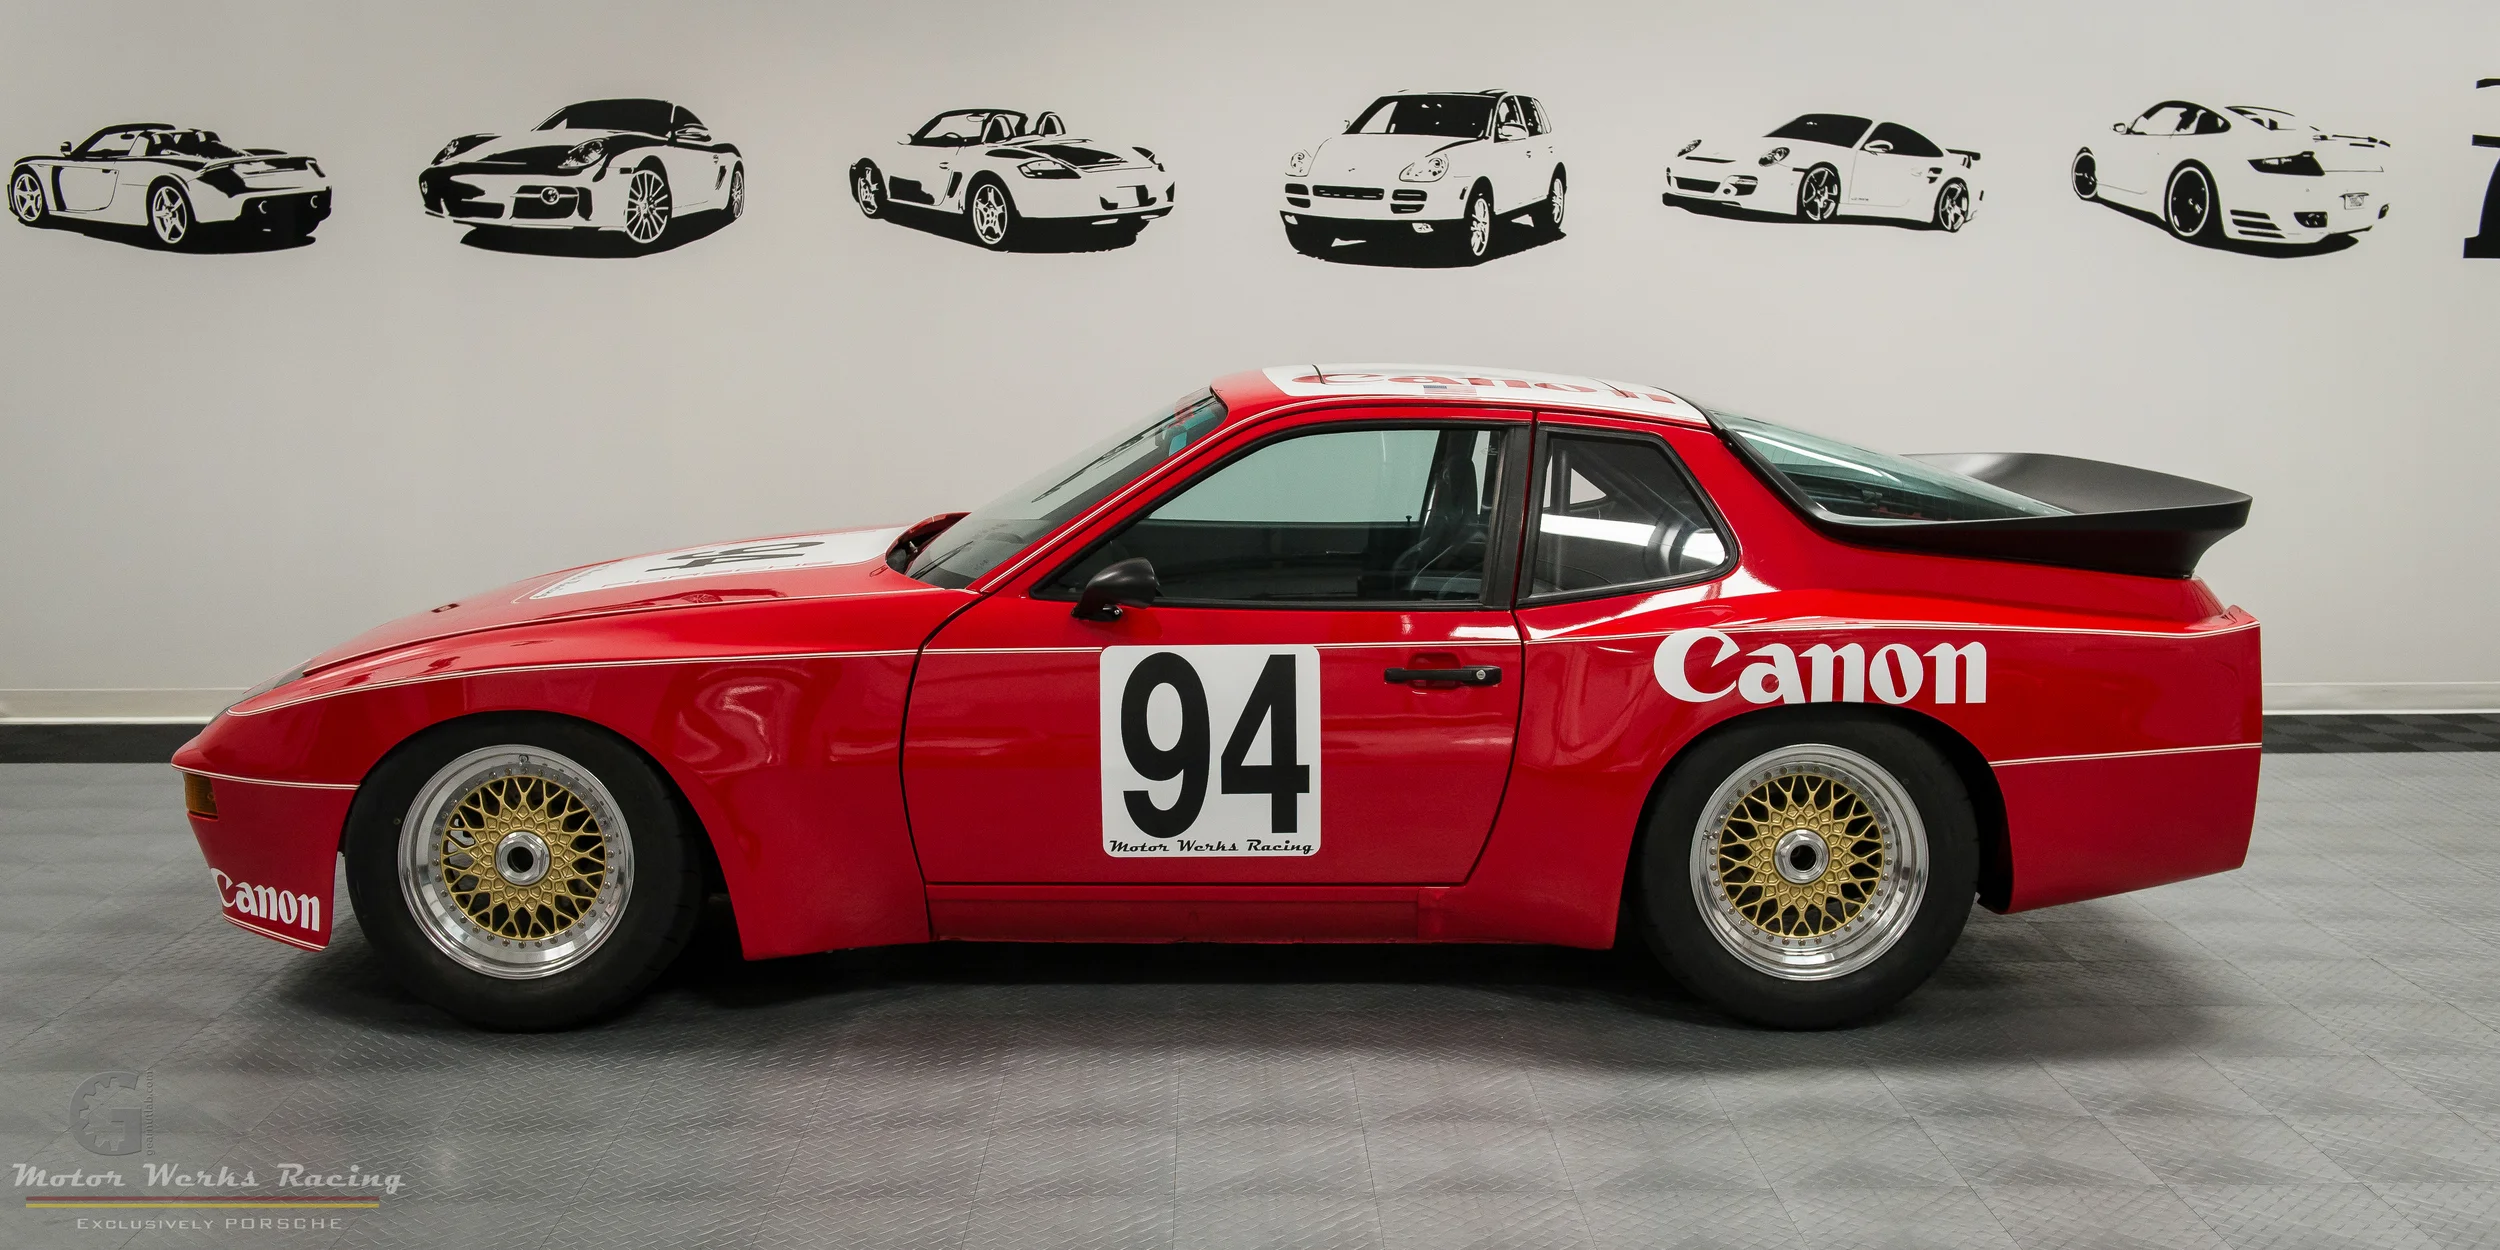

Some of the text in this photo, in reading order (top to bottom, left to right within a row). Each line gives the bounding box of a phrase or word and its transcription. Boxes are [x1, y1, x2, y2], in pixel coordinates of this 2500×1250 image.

[1291, 373, 1677, 405] Canon
[1653, 627, 1987, 704] Canon
[1120, 651, 1310, 838] 94
[1109, 839, 1315, 855] Motor Werks Racing
[210, 867, 320, 932] Canon
